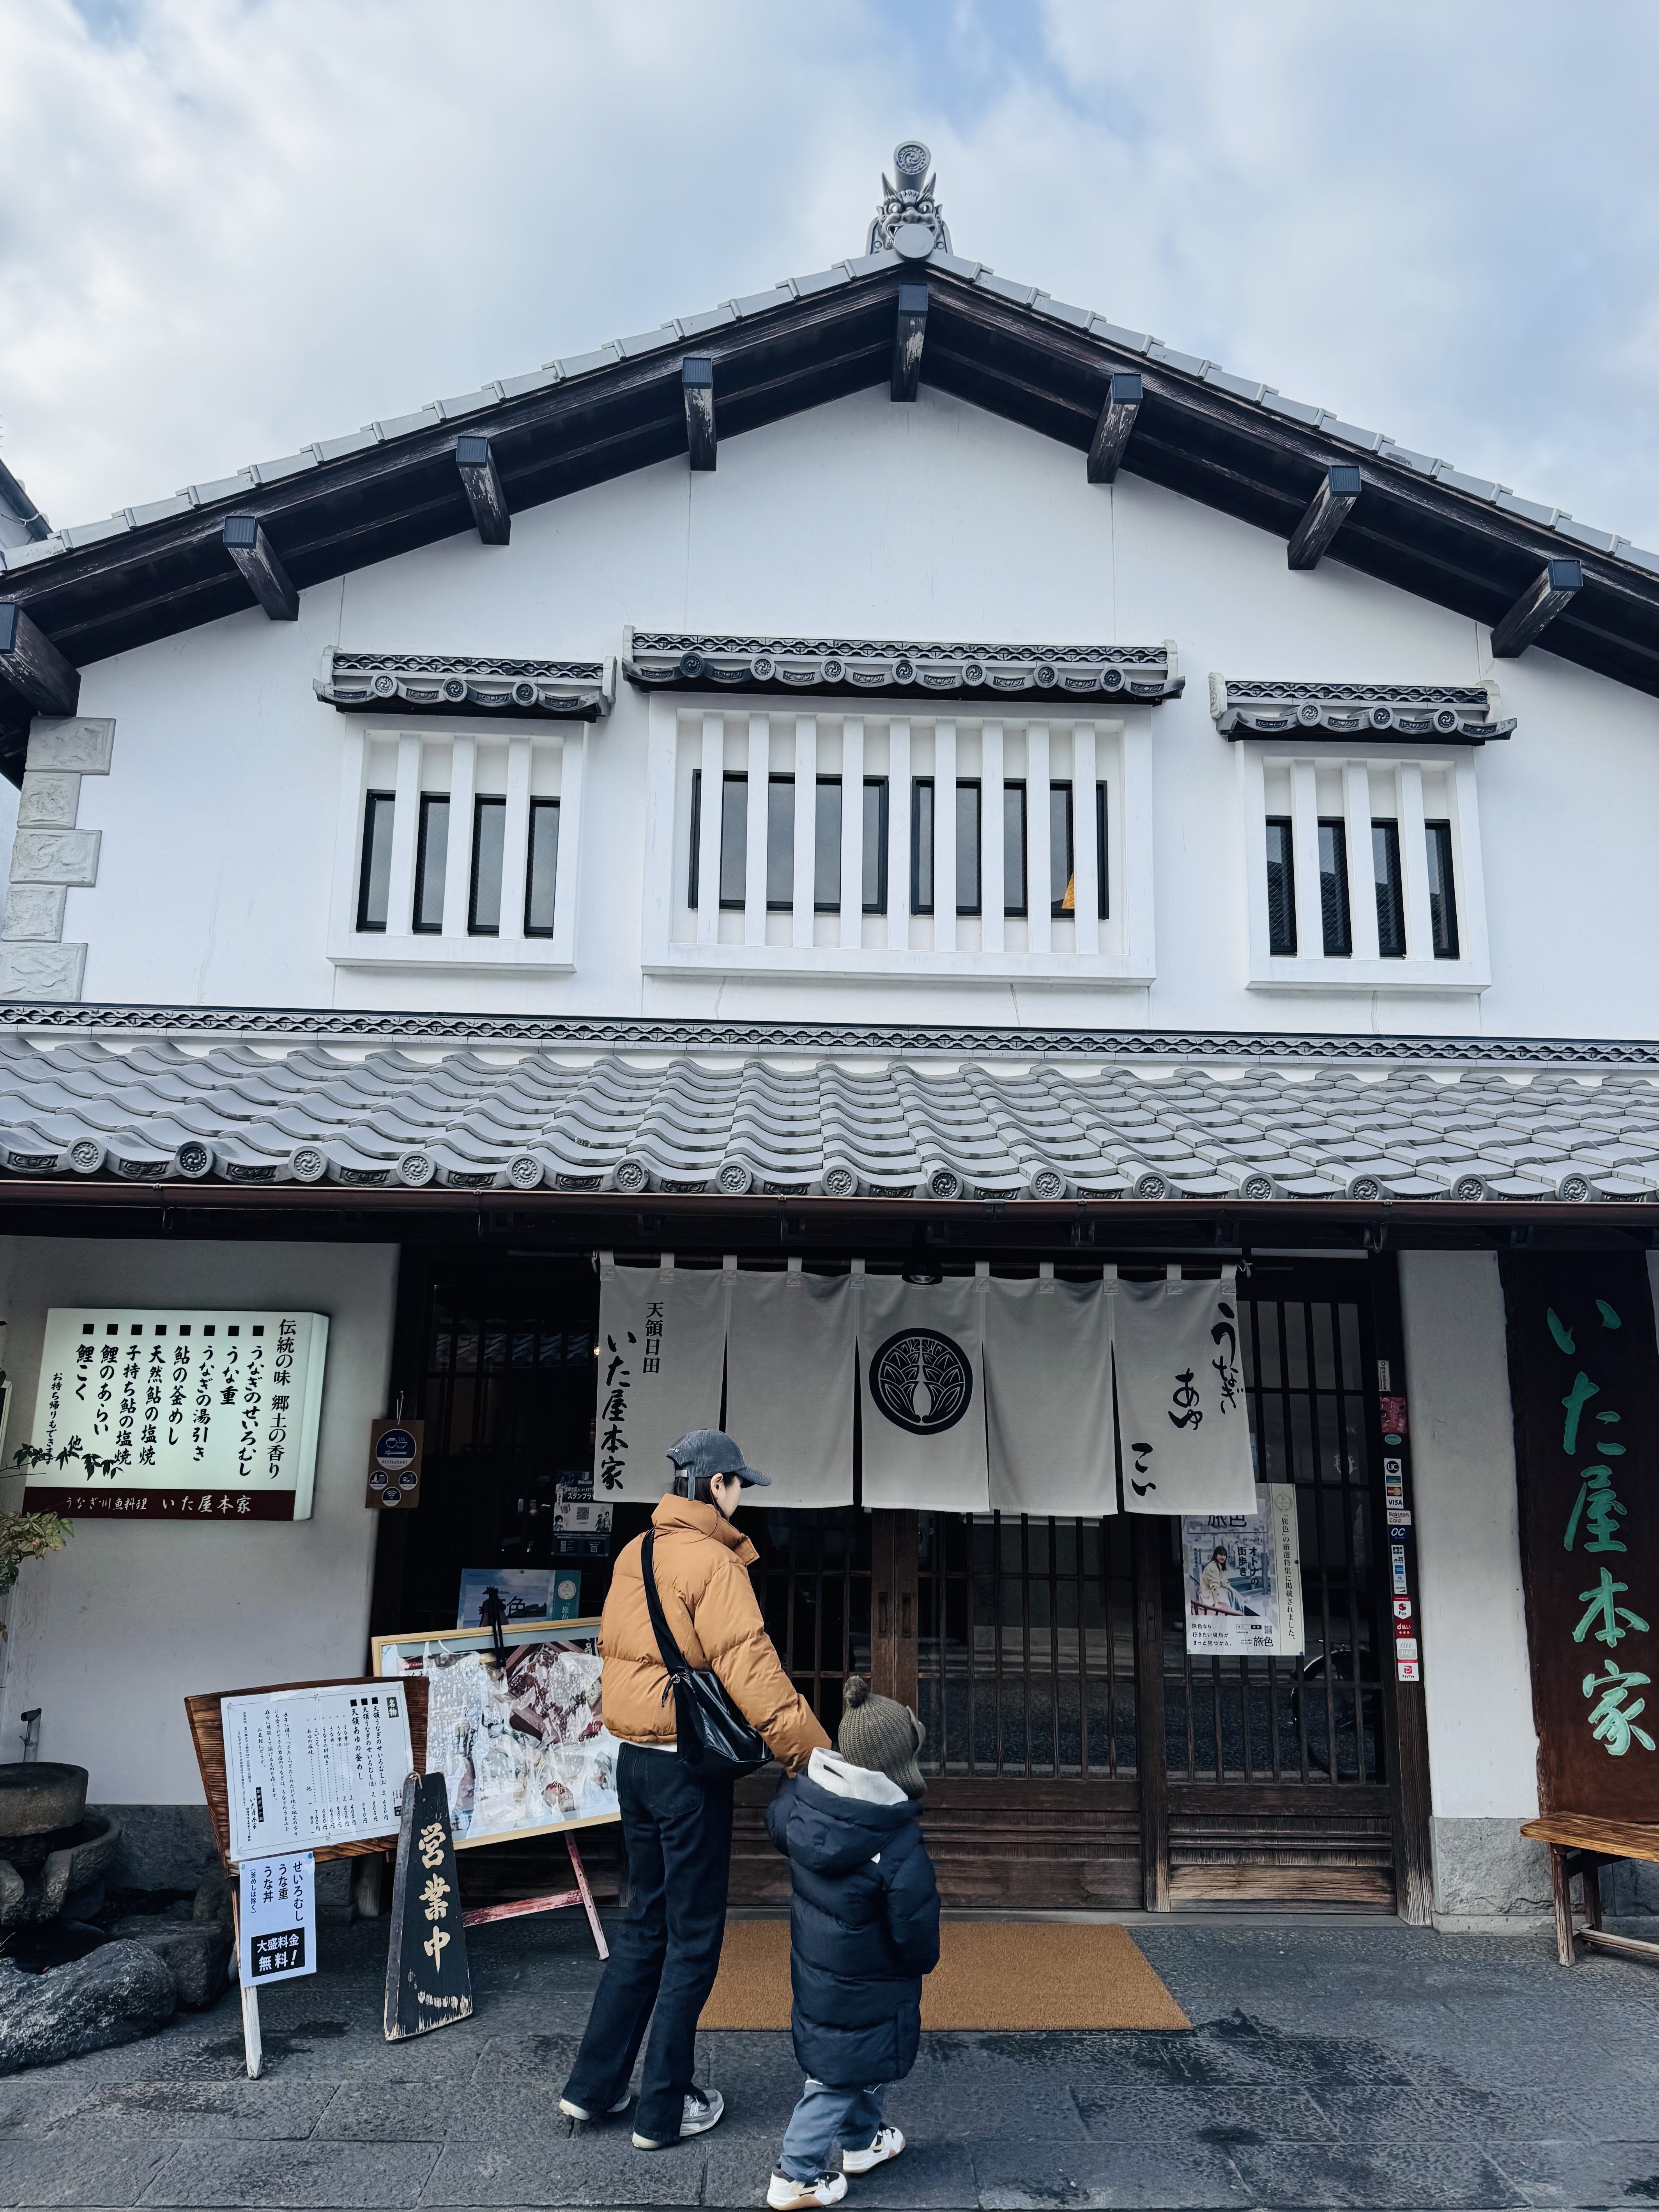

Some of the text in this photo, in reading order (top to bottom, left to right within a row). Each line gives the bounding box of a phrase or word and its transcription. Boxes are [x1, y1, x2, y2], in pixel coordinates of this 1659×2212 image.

[643, 1302, 664, 1374] 天領日田
[75, 1344, 95, 1401] 鯉こく
[93, 1344, 119, 1436] 鯉のあらい
[113, 1345, 141, 1466] 子持ち鮎の塩焼
[138, 1345, 166, 1466] 天然鮎の塩焼
[168, 1345, 190, 1446] 鮎の釜めし
[192, 1345, 214, 1461] うなぎの湯引き
[220, 1346, 241, 1405] うな重
[267, 1319, 297, 1479] 伝統の味 郷土の香り
[1168, 1368, 1203, 1431] あゆ
[238, 1345, 265, 1477] うなぎのせいろむし
[601, 1331, 637, 1491] いた屋本家
[162, 1495, 251, 1514] いた屋本家
[1546, 1299, 1657, 1756] いた屋本家
[1238, 1546, 1247, 1576] 街歩き
[1249, 1546, 1259, 1586] オトナの
[1254, 1636, 1273, 1647] 旅色
[388, 1699, 397, 1716] 名物
[352, 1708, 363, 1780] 天領あゆの釜めし
[263, 1866, 273, 1903] うな丼
[278, 1864, 288, 1900] うな重
[293, 1861, 303, 1922] せいろむし
[418, 1822, 451, 1974] 営業中
[257, 1934, 299, 1953] 大盛料金
